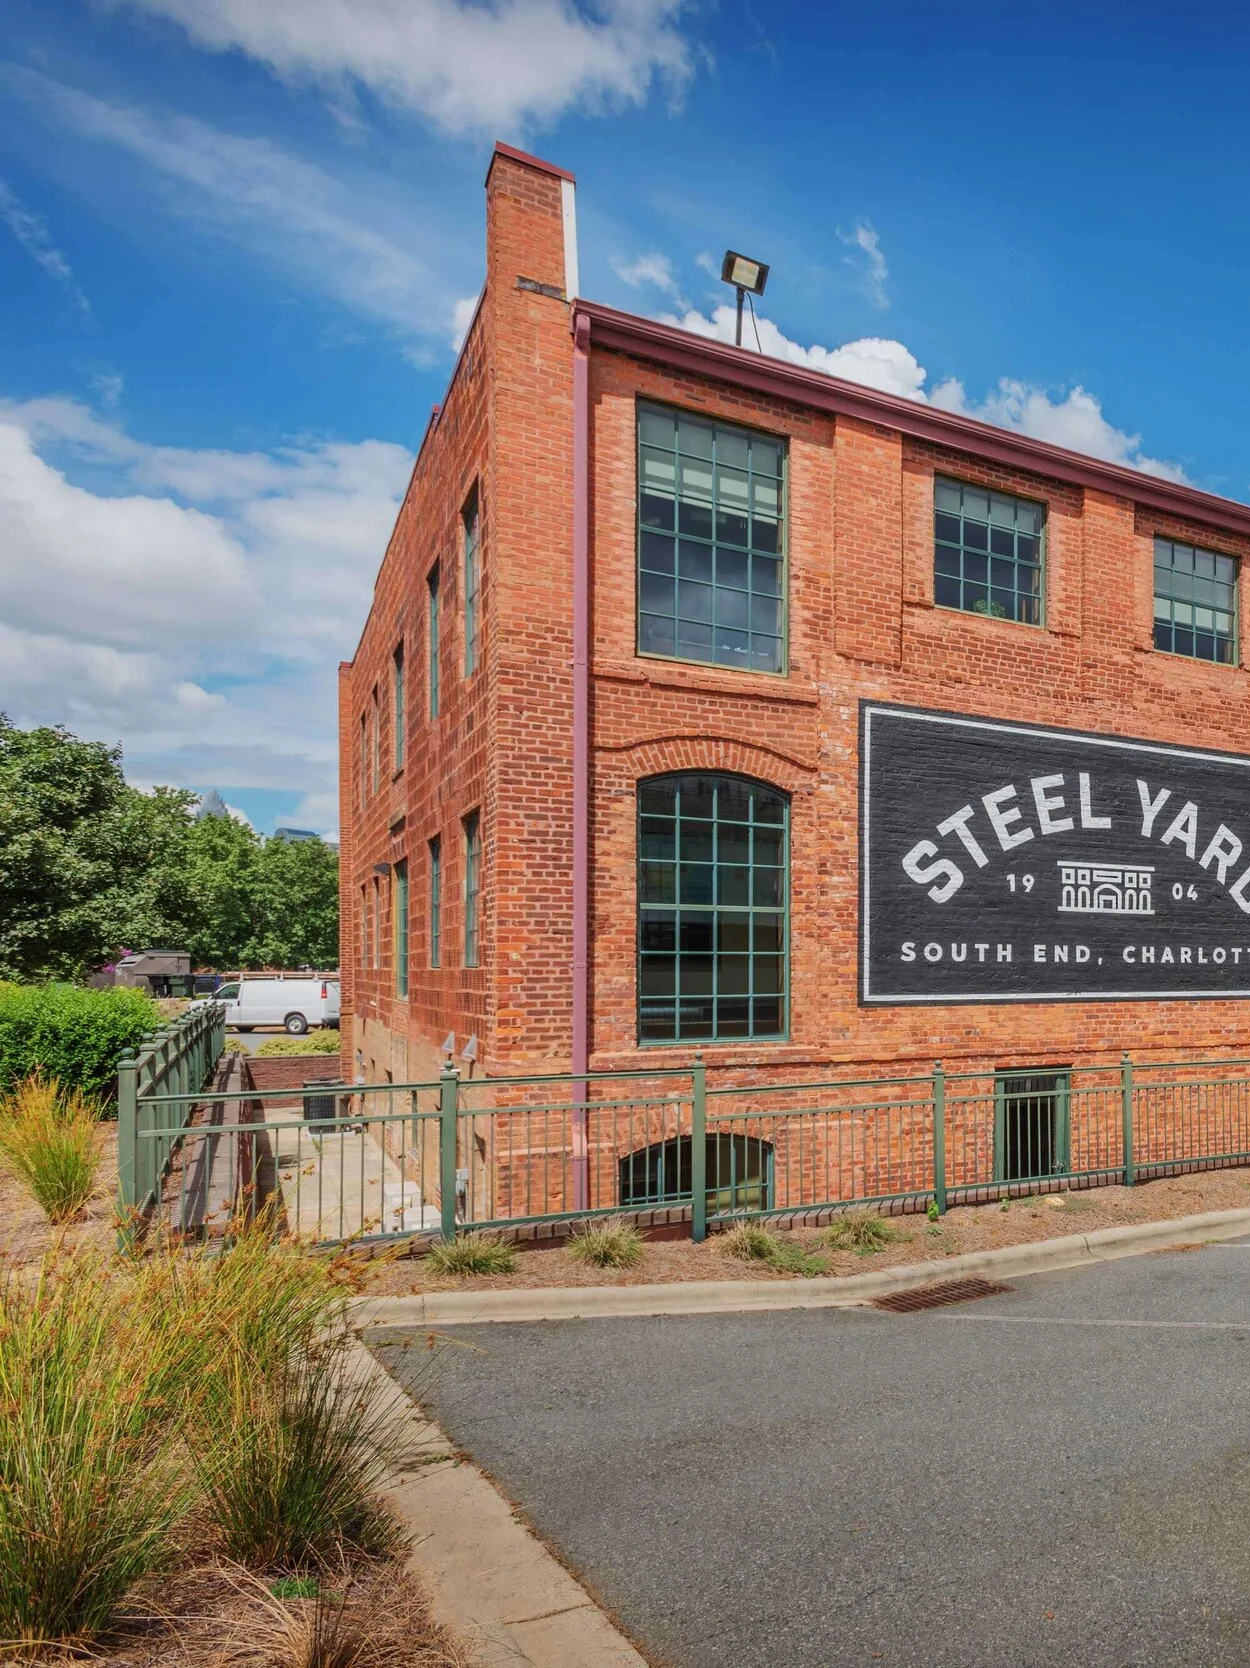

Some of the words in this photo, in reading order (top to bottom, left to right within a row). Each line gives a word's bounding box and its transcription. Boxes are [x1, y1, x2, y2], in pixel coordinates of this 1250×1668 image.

[901, 772, 1112, 904] STEEL
[1006, 873, 1035, 893] 19
[1172, 882, 1199, 901] 04
[900, 942, 1012, 963] SOUTH
[1033, 944, 1103, 966] END,
